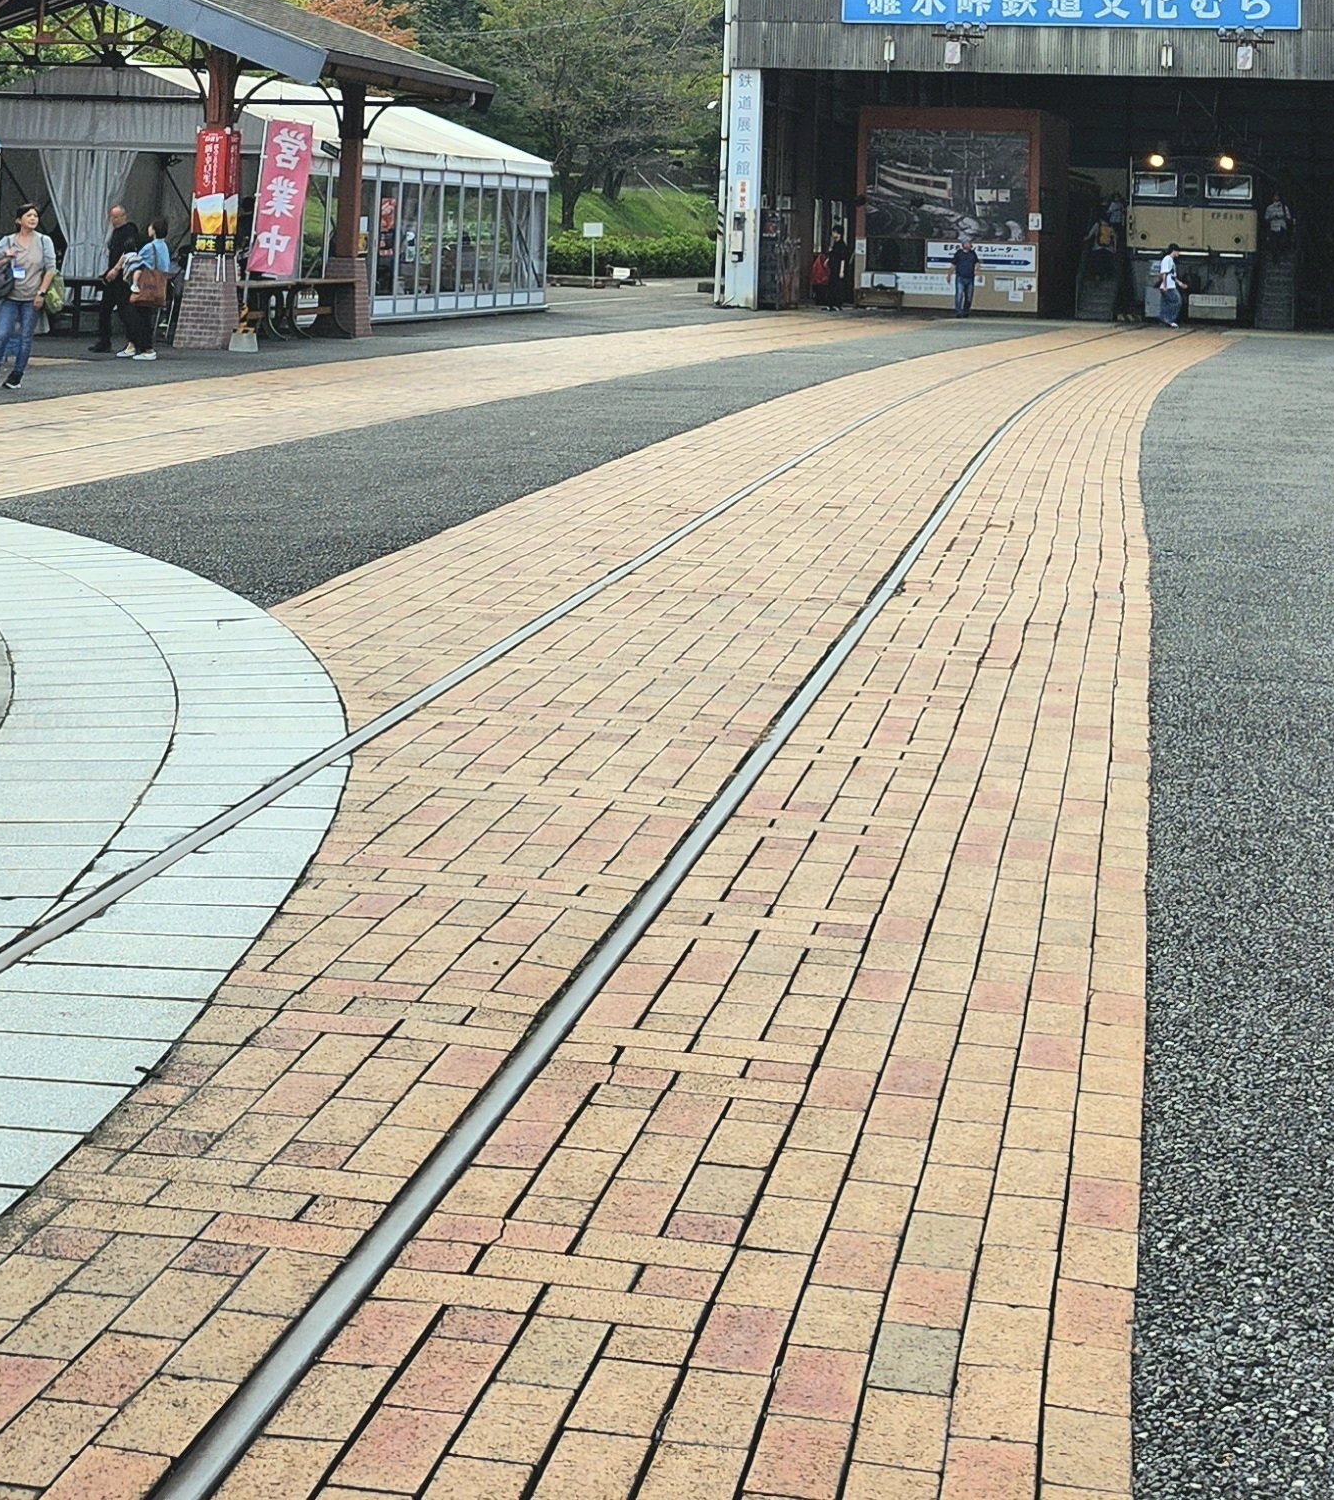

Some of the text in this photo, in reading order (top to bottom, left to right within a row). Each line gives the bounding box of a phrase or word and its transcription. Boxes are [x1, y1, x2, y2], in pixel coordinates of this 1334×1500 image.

[735, 73, 753, 176] 鉄道展示館
[257, 127, 308, 266] 営業中
